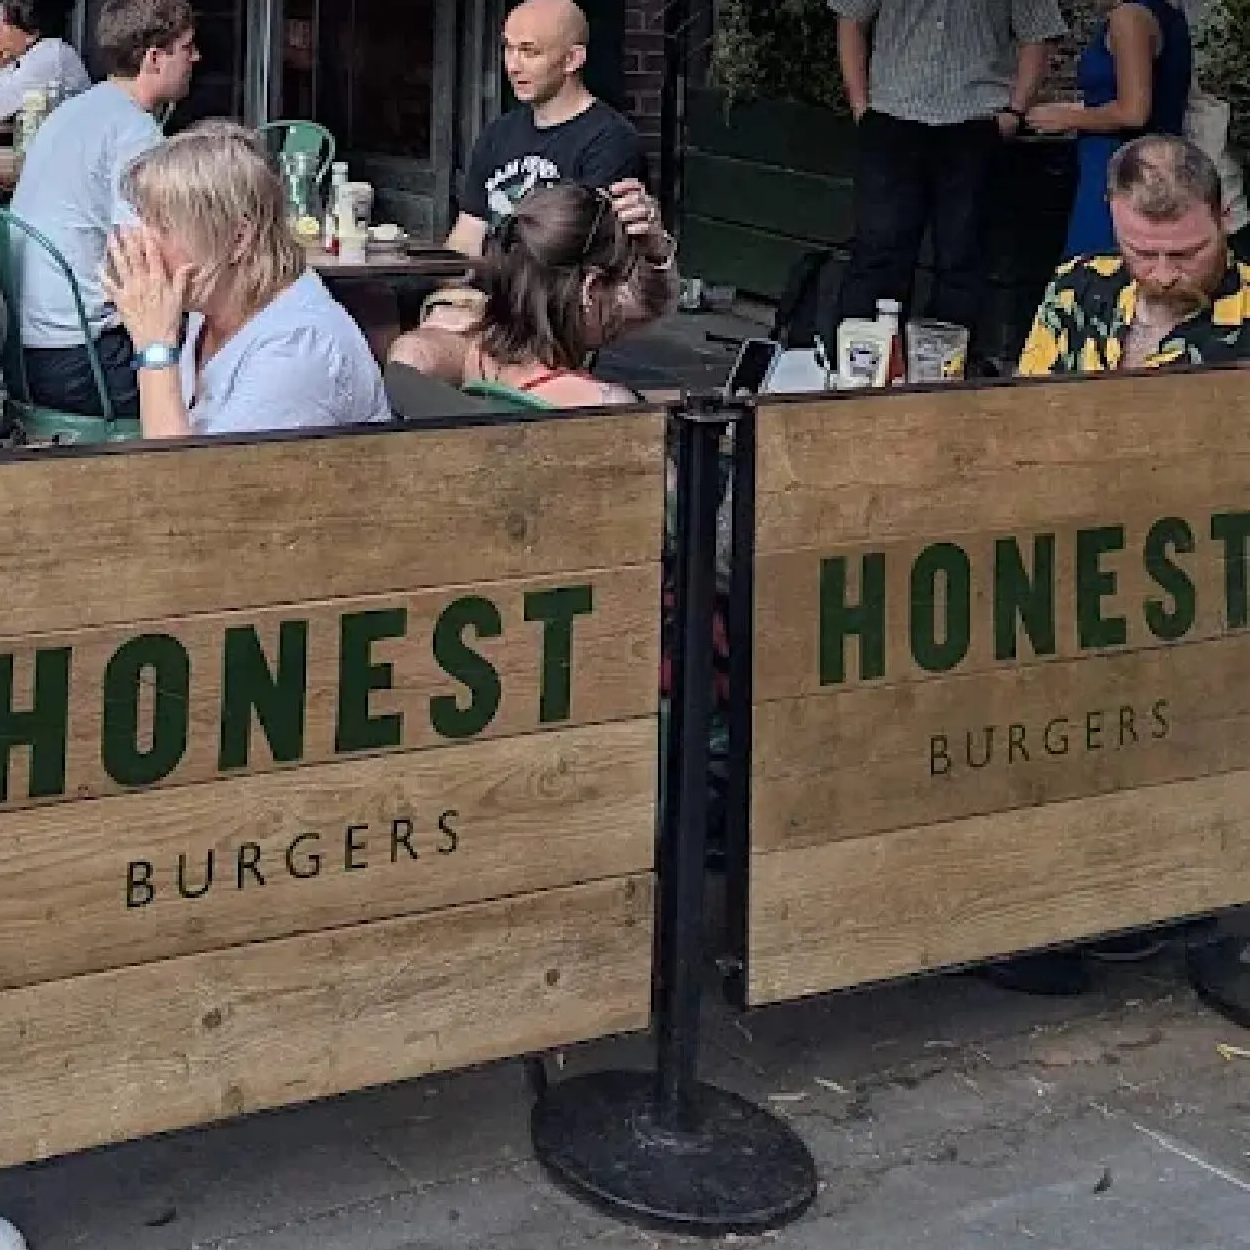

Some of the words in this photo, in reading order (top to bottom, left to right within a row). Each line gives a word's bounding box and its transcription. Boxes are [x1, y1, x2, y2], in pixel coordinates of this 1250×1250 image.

[819, 513, 1250, 686] HONEST
[930, 699, 1171, 777] BURGERS
[125, 809, 460, 908] BURGERS
